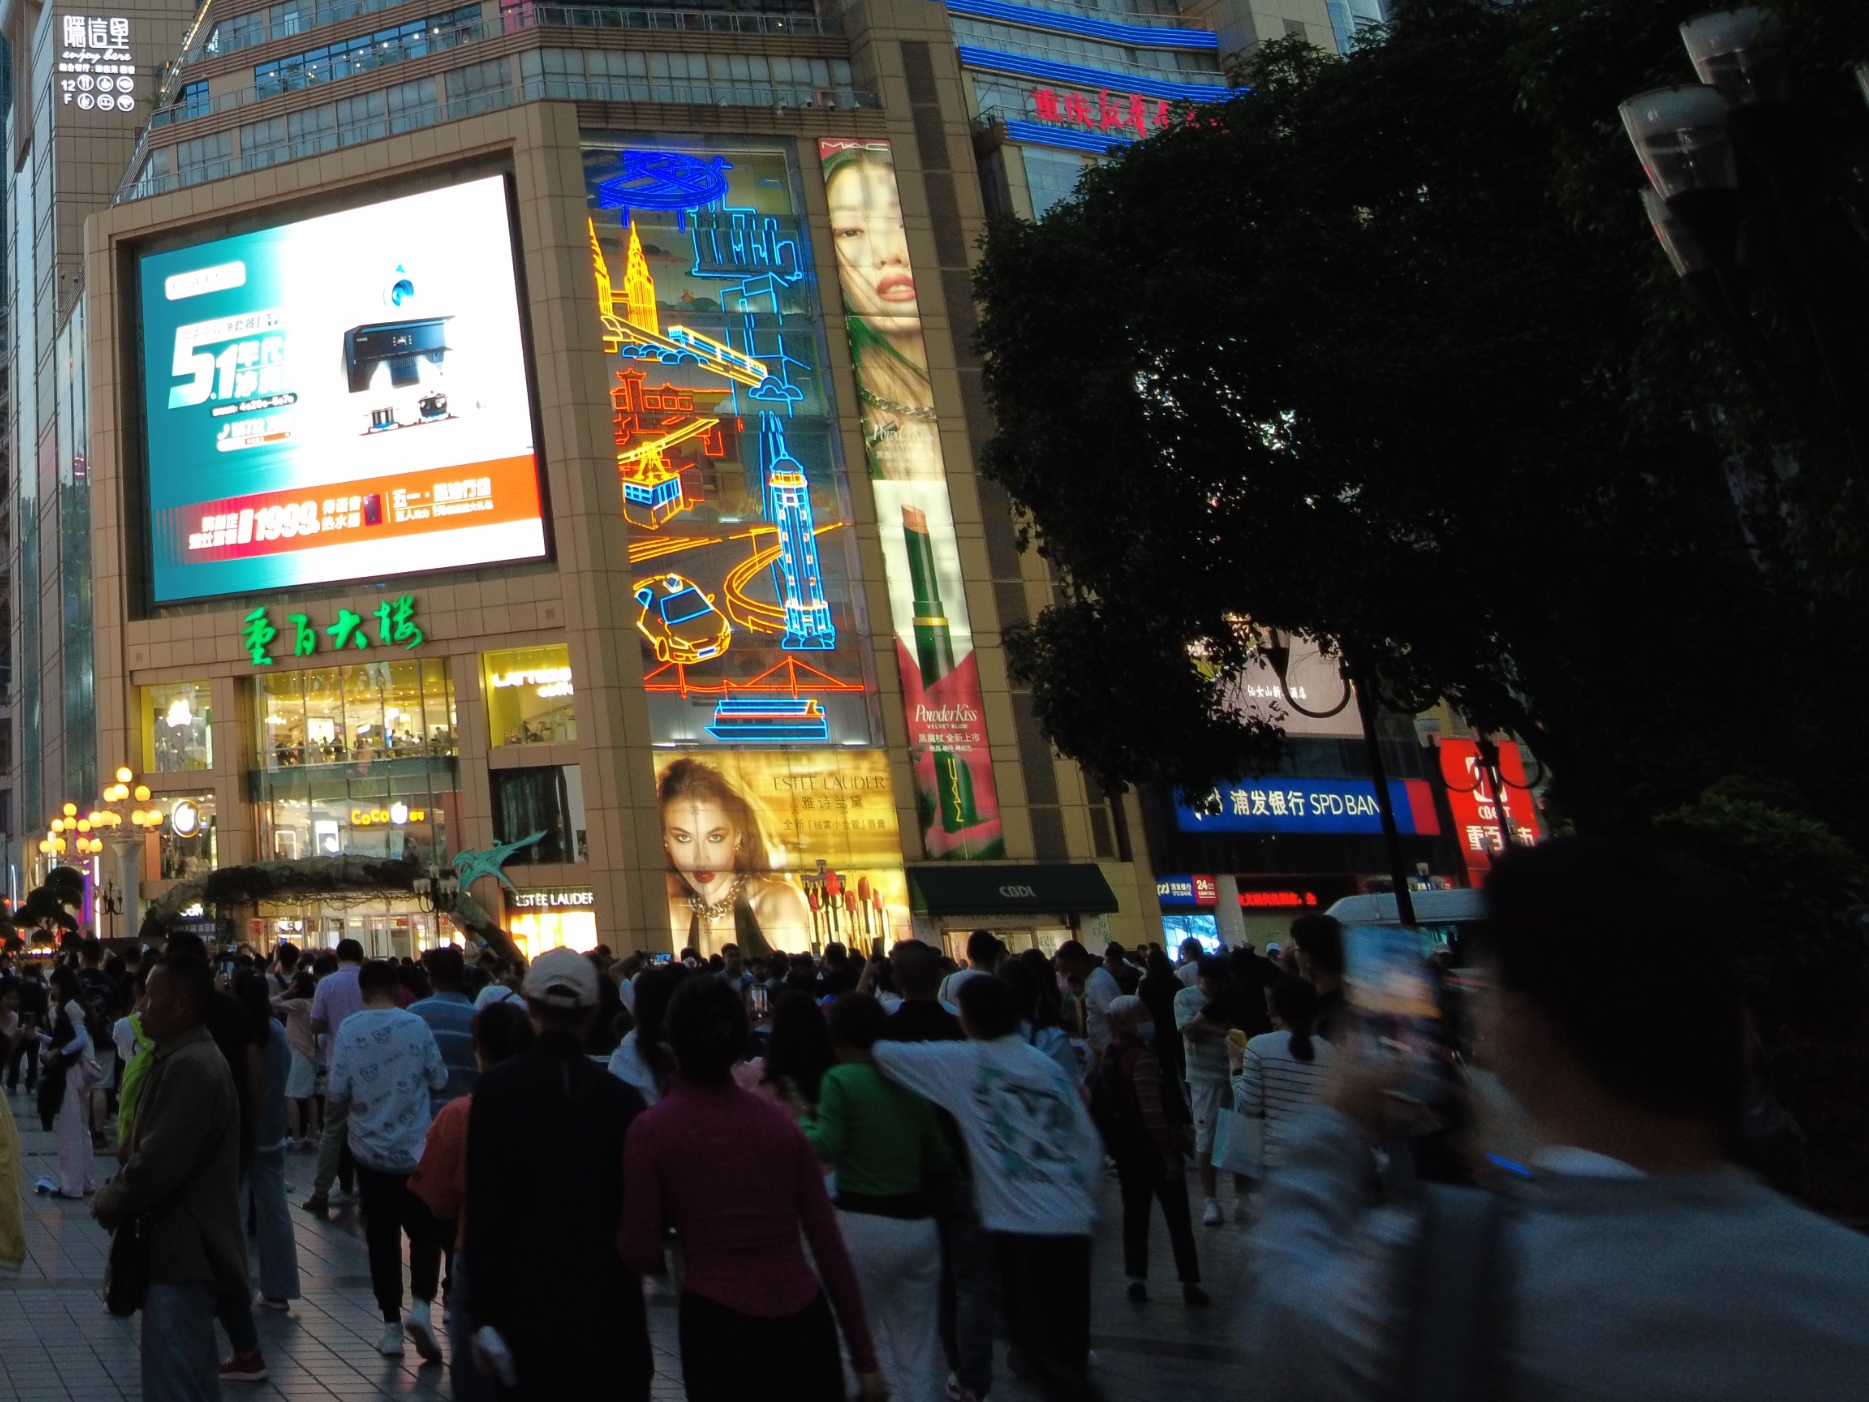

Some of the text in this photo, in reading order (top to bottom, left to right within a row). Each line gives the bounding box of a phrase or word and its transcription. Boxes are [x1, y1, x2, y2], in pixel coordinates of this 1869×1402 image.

[62, 48, 132, 64] enjoy here
[60, 80, 76, 92] 12
[241, 594, 423, 667] 重百大楼
[1247, 684, 1307, 700] 仙女山新酒店
[946, 732, 980, 743] 全新上市
[822, 775, 886, 790] LAUDER
[801, 794, 864, 810] 雅诗兰黛
[1229, 789, 1305, 816] 浦发银行
[1309, 793, 1382, 816] SPD BAN
[1465, 825, 1535, 851] 重百市
